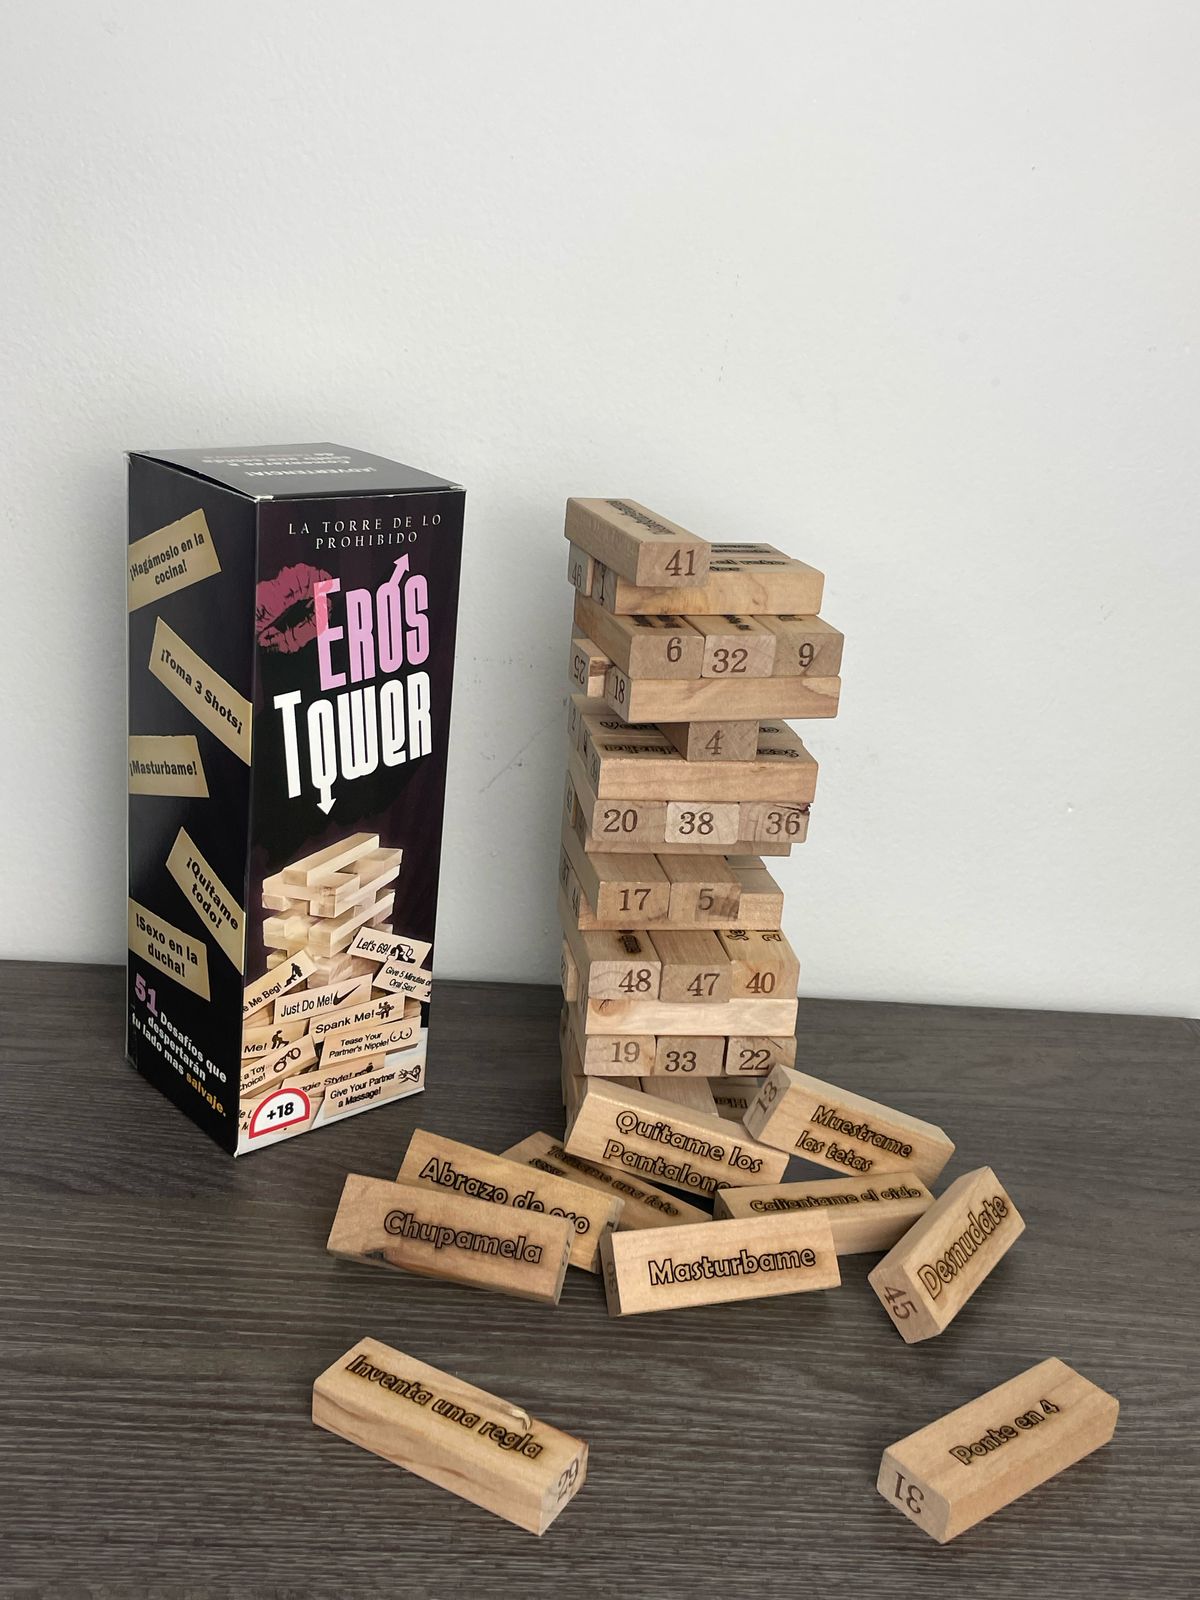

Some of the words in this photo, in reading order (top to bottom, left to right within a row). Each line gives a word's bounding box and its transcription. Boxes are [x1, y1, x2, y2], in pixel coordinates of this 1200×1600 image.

[289, 522, 310, 535] LA
[322, 518, 383, 533] TORRE
[393, 516, 412, 529] DE
[422, 514, 441, 526] LO
[181, 538, 193, 553] en
[193, 532, 205, 547] la
[315, 531, 417, 550] PROHIBIDO
[155, 559, 187, 585] cocina!
[571, 561, 582, 588] 46
[664, 550, 697, 577] 41
[313, 565, 430, 691] EROS
[666, 637, 683, 663] 6
[711, 648, 749, 674] 32
[798, 643, 815, 668] 9
[160, 648, 192, 686] ¡Toma
[194, 680, 203, 695] 3
[614, 675, 626, 704] 18
[705, 729, 725, 755] 4
[129, 760, 198, 777] ¡Masturbame!
[603, 808, 638, 833] 20
[678, 811, 715, 835] 38
[765, 811, 801, 835] 36
[186, 857, 239, 930] ¡Quitame
[191, 883, 223, 929] todo!
[619, 888, 652, 911] 17
[698, 888, 715, 911] 5
[168, 939, 183, 957] en
[186, 945, 198, 966] la
[356, 937, 377, 952] Let's
[376, 942, 392, 955] 69!
[147, 942, 186, 978] ducha!
[385, 966, 399, 977] Give
[400, 970, 406, 978] 5
[405, 971, 426, 985] Minutes
[389, 978, 402, 988] Oral
[402, 982, 416, 992] Sex!
[618, 969, 652, 993] 48
[687, 973, 721, 997] 47
[745, 972, 776, 994] 40
[248, 996, 263, 1008] Me
[261, 982, 282, 999] Beg!
[281, 1003, 300, 1018] Just
[302, 999, 314, 1012] Do
[316, 993, 334, 1008] Me!
[134, 972, 158, 1017] 51
[160, 1011, 204, 1062] Desafíos
[206, 1059, 227, 1083] que
[315, 1016, 351, 1034] Spank
[354, 1009, 375, 1023] Me!
[147, 1017, 206, 1082] despertarán
[244, 1042, 267, 1054] Me!
[329, 1045, 362, 1059] Partner's
[363, 1039, 390, 1052] Nipple!
[340, 1036, 363, 1047] Tease
[364, 1032, 383, 1041] Your
[611, 1041, 641, 1063] 19
[132, 1012, 141, 1030] tu
[142, 1024, 162, 1052] lado
[164, 1049, 184, 1076] mas
[186, 1072, 227, 1117] salvaje.
[250, 1064, 265, 1076] Toy
[664, 1051, 697, 1073] 33
[739, 1049, 771, 1071] 22
[330, 1088, 348, 1100] Give
[349, 1080, 368, 1093] Your
[368, 1071, 396, 1087] Partner
[338, 1100, 344, 1108] a
[345, 1087, 382, 1106] Massage!
[756, 1081, 777, 1113] 13
[266, 1101, 294, 1120] +18
[615, 1110, 725, 1161] Quitame
[728, 1146, 764, 1173] los
[810, 1104, 913, 1158] Muestrame
[795, 1130, 825, 1154] las
[825, 1142, 873, 1173] tetas
[602, 1138, 740, 1192] Pantalone
[419, 1156, 509, 1205] Abrazo
[512, 1190, 545, 1213] de
[750, 1190, 859, 1213] Calientame
[860, 1189, 880, 1201] el
[383, 1209, 543, 1264] Chupamela
[917, 1196, 1009, 1301] Desnudate
[647, 1246, 816, 1287] Masturbame
[884, 1286, 918, 1320] 45
[345, 1354, 433, 1406] Inventa
[431, 1398, 480, 1429] una
[479, 1419, 544, 1460] regla
[949, 1424, 1018, 1466] Ponte
[1014, 1408, 1045, 1431] en
[1039, 1398, 1060, 1416] 4
[557, 1458, 579, 1503] 29
[894, 1470, 925, 1515] 31
